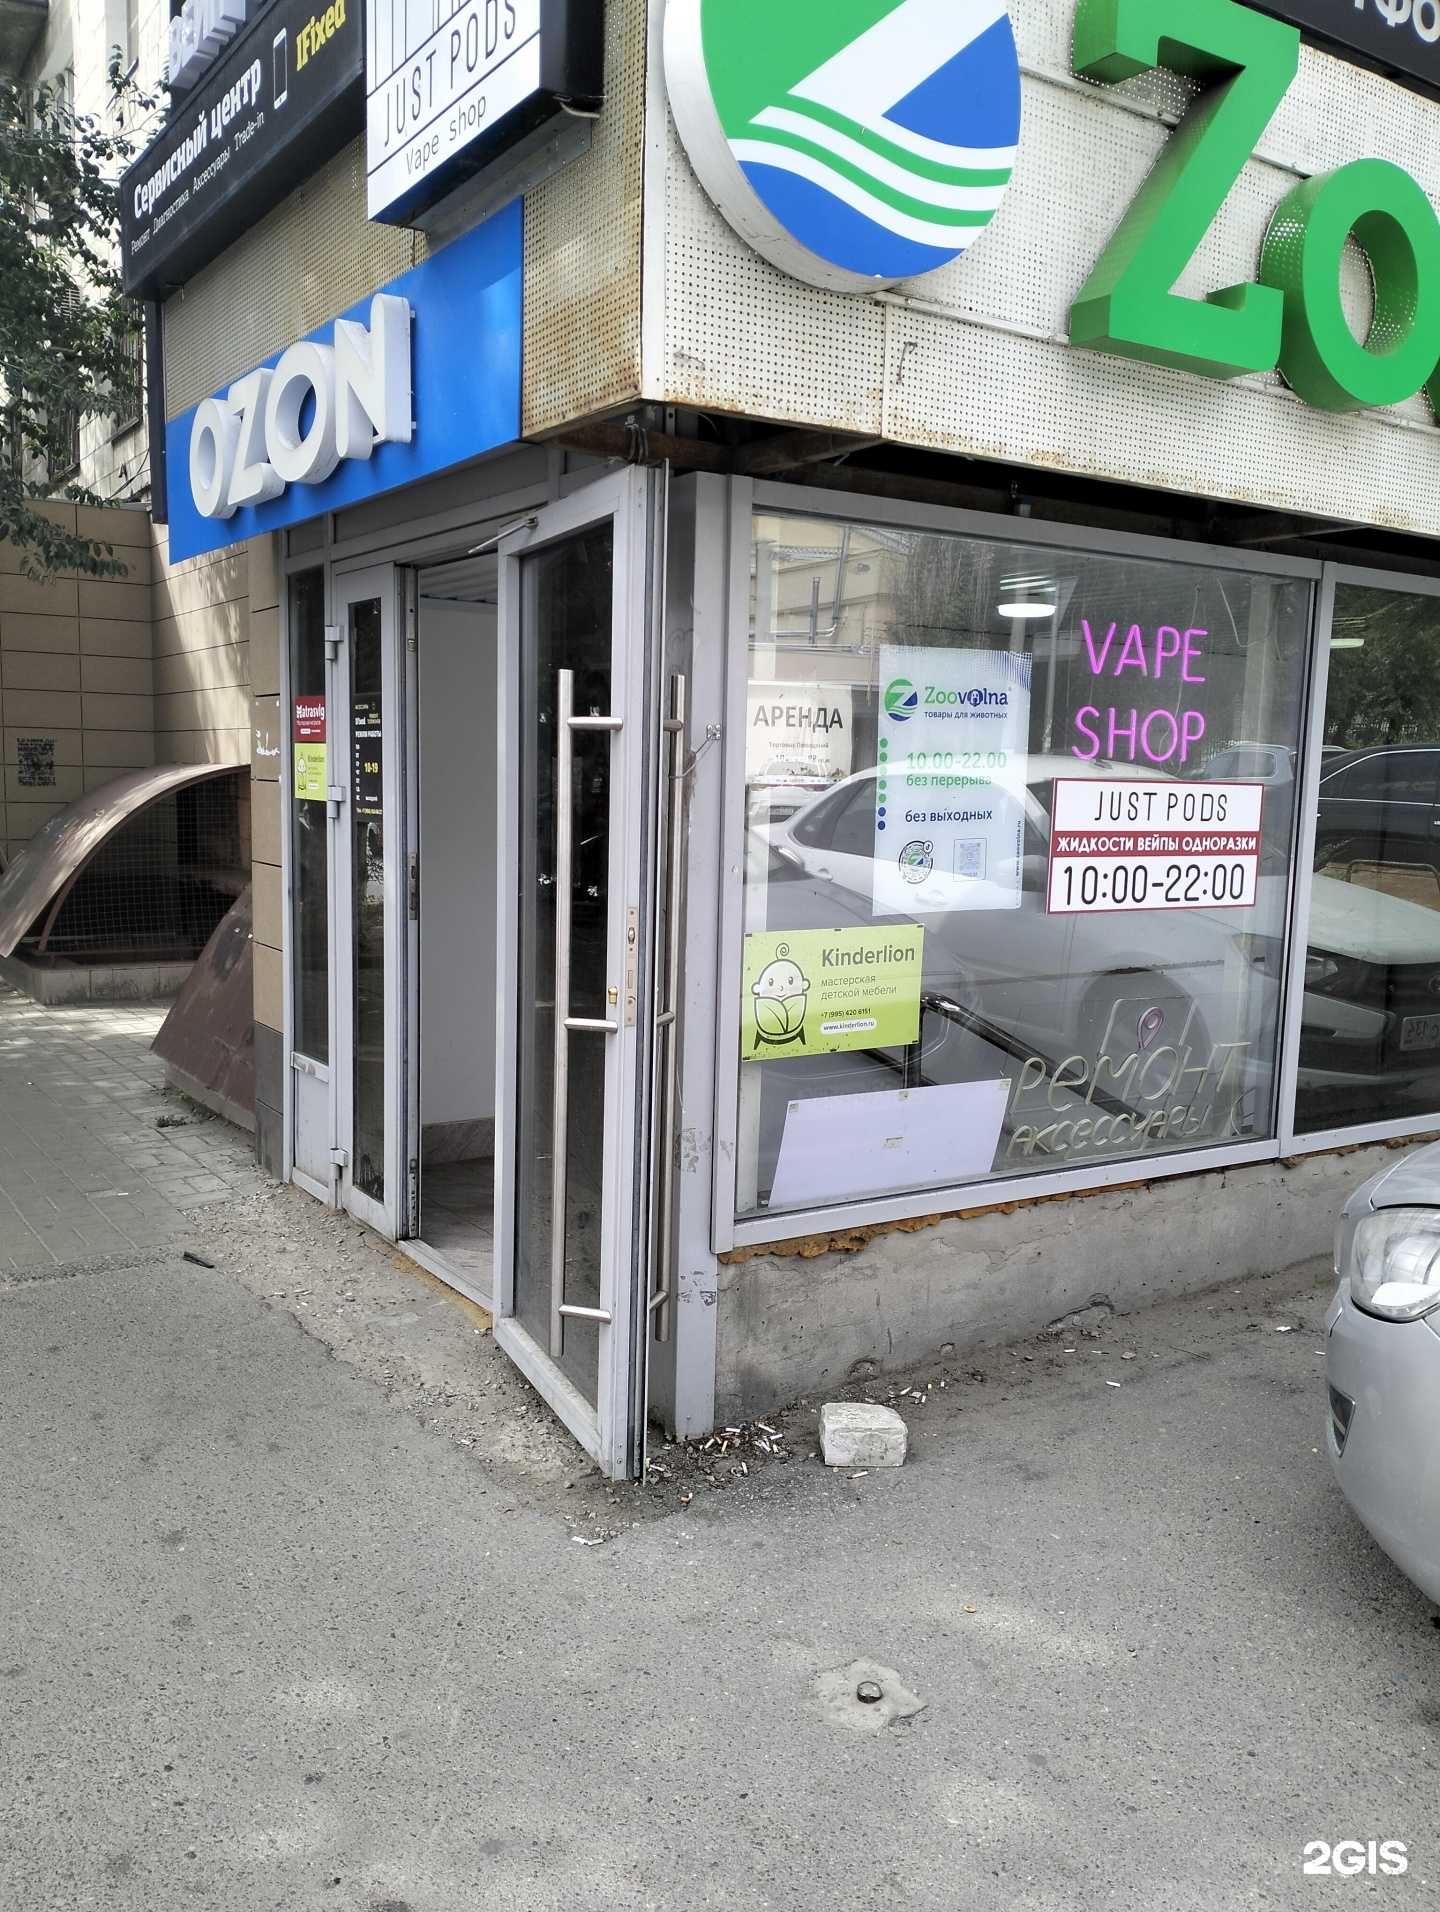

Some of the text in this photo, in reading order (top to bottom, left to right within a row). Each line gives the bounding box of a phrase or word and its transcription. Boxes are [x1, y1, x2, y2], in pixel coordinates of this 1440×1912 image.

[296, 0, 346, 72] IFixed
[1354, 0, 1440, 43] ФО
[384, 0, 517, 148] JUST PODS
[134, 58, 262, 219] Сервисный центр
[234, 111, 265, 151] Trade-in
[405, 95, 487, 175] Vape shop
[1068, 0, 1440, 412] Zo
[189, 292, 413, 520] OZON
[1080, 619, 1209, 683] VAPE
[753, 704, 844, 734] АРЕНДА
[924, 710, 1009, 720] товары для животных
[1071, 705, 1206, 763] SHOP
[906, 774, 992, 789] без перерыва
[905, 810, 993, 823] без выходных
[1094, 791, 1229, 823] JUST PODS
[1056, 833, 1257, 853] ЖИДКОСТИ ВЕЙПЫ ОДНОРАЗКИ
[1063, 862, 1246, 906] 10:00-22:00
[821, 945, 916, 968] Kinderlion
[820, 974, 877, 988] мастерская
[820, 985, 898, 1001] детской мебели
[822, 1020, 876, 1032] www.kinderlion.ru
